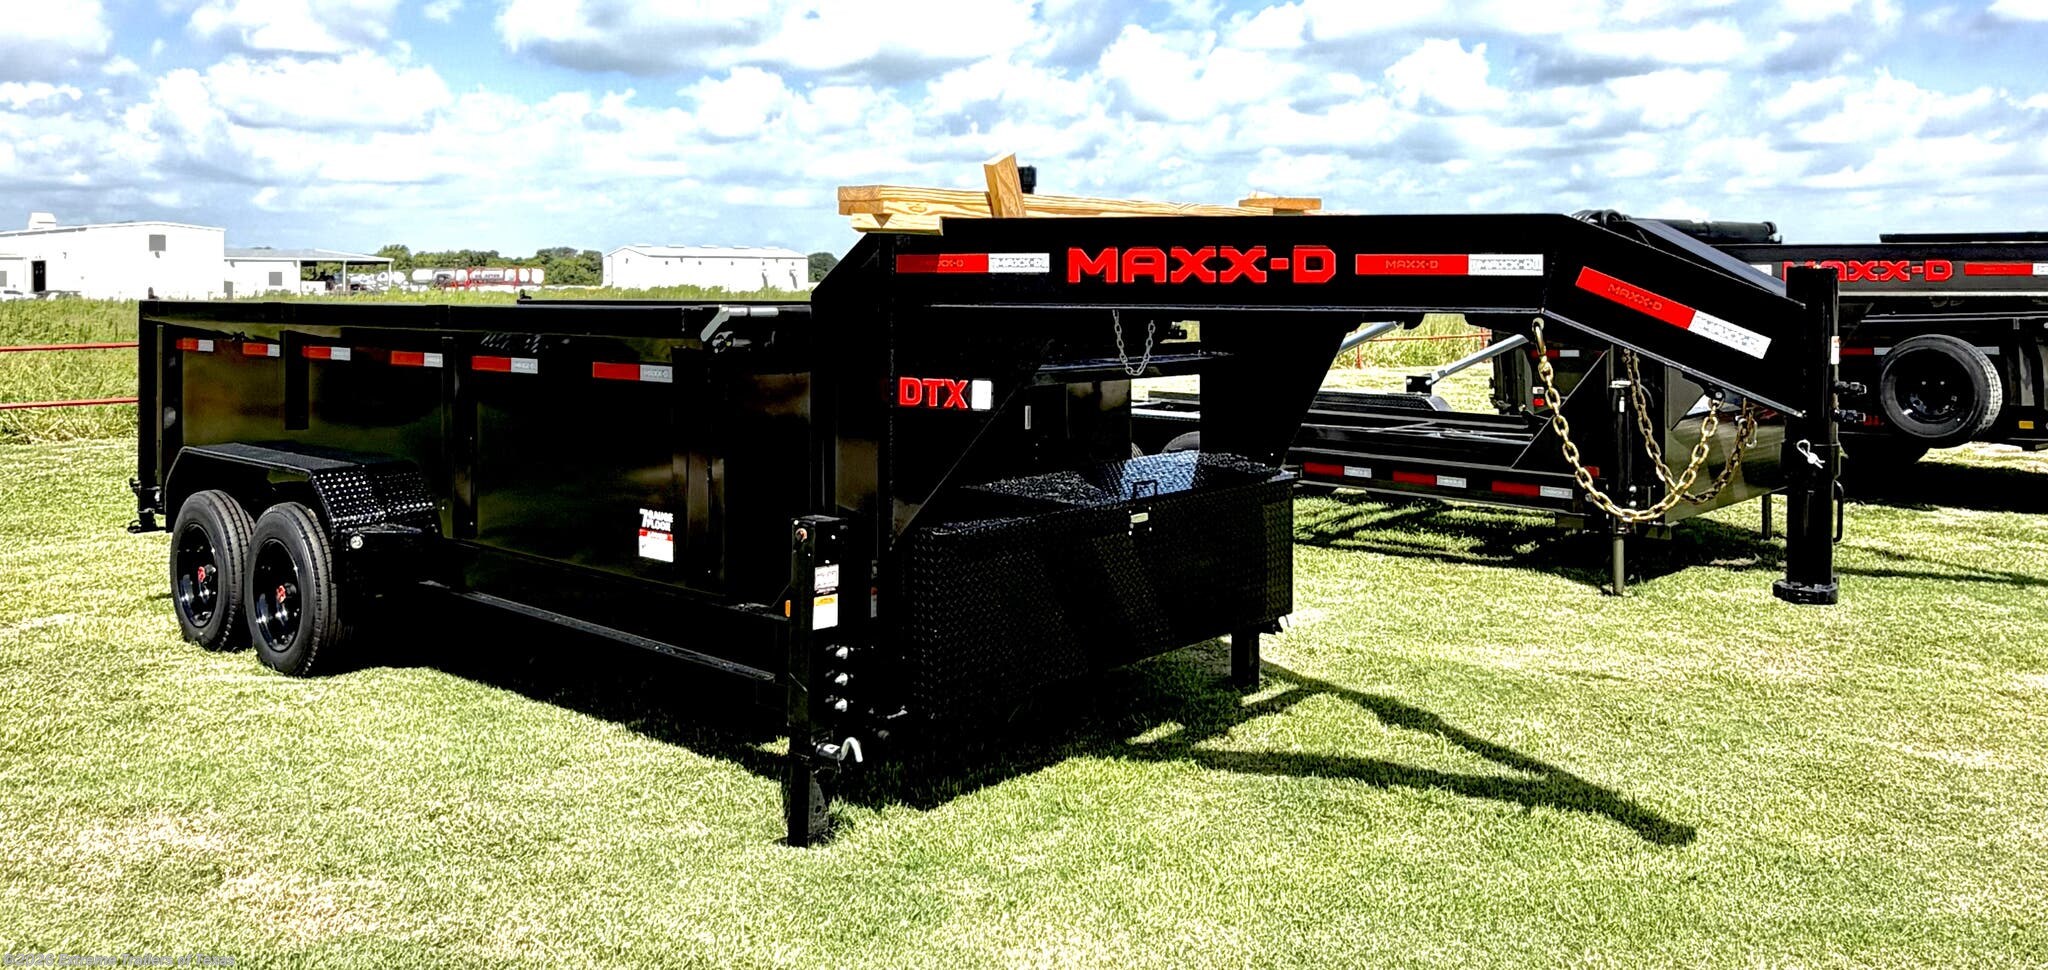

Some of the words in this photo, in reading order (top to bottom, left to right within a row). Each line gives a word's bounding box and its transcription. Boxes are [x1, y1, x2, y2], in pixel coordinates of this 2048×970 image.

[1067, 246, 1336, 283] MAXX-D
[1385, 259, 1439, 270] MAXX-D
[1607, 283, 1663, 311] MAXX-D
[899, 377, 968, 408] DTX
